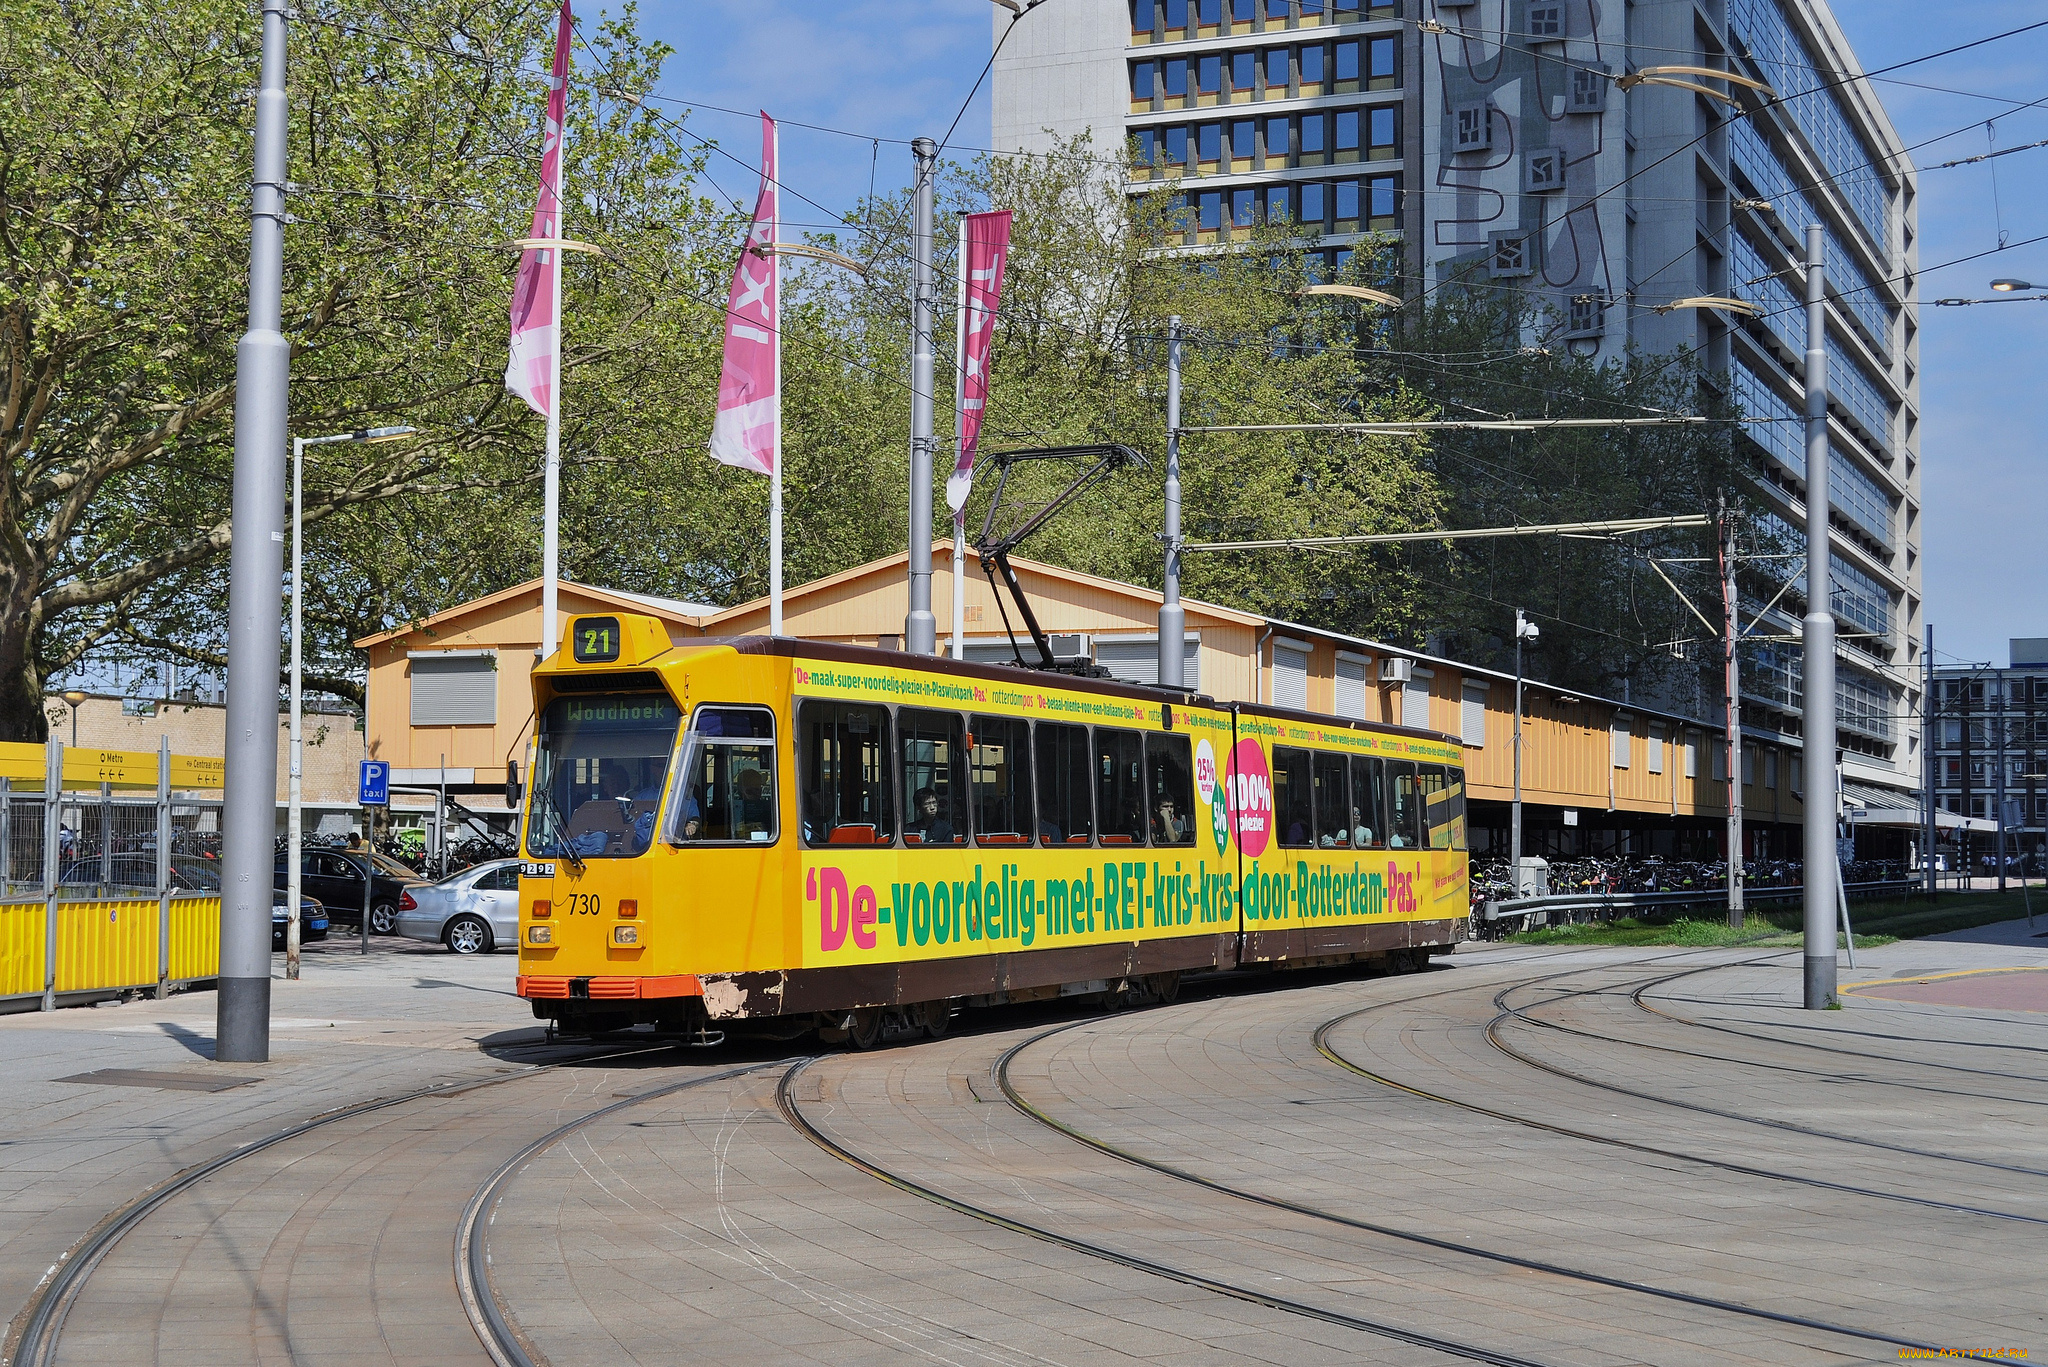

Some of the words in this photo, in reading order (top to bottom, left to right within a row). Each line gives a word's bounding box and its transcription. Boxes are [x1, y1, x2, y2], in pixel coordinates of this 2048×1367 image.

[963, 253, 999, 410] TAXI
[584, 629, 610, 654] 21
[567, 699, 665, 721] Woudhoek
[106, 753, 124, 764] Metro
[193, 759, 213, 769] Centraal
[366, 765, 382, 786] P
[1197, 758, 1215, 782] 25%
[363, 789, 384, 798] taxi
[1226, 773, 1271, 812] 100%
[520, 864, 553, 873] 9292
[569, 893, 600, 916] 730
